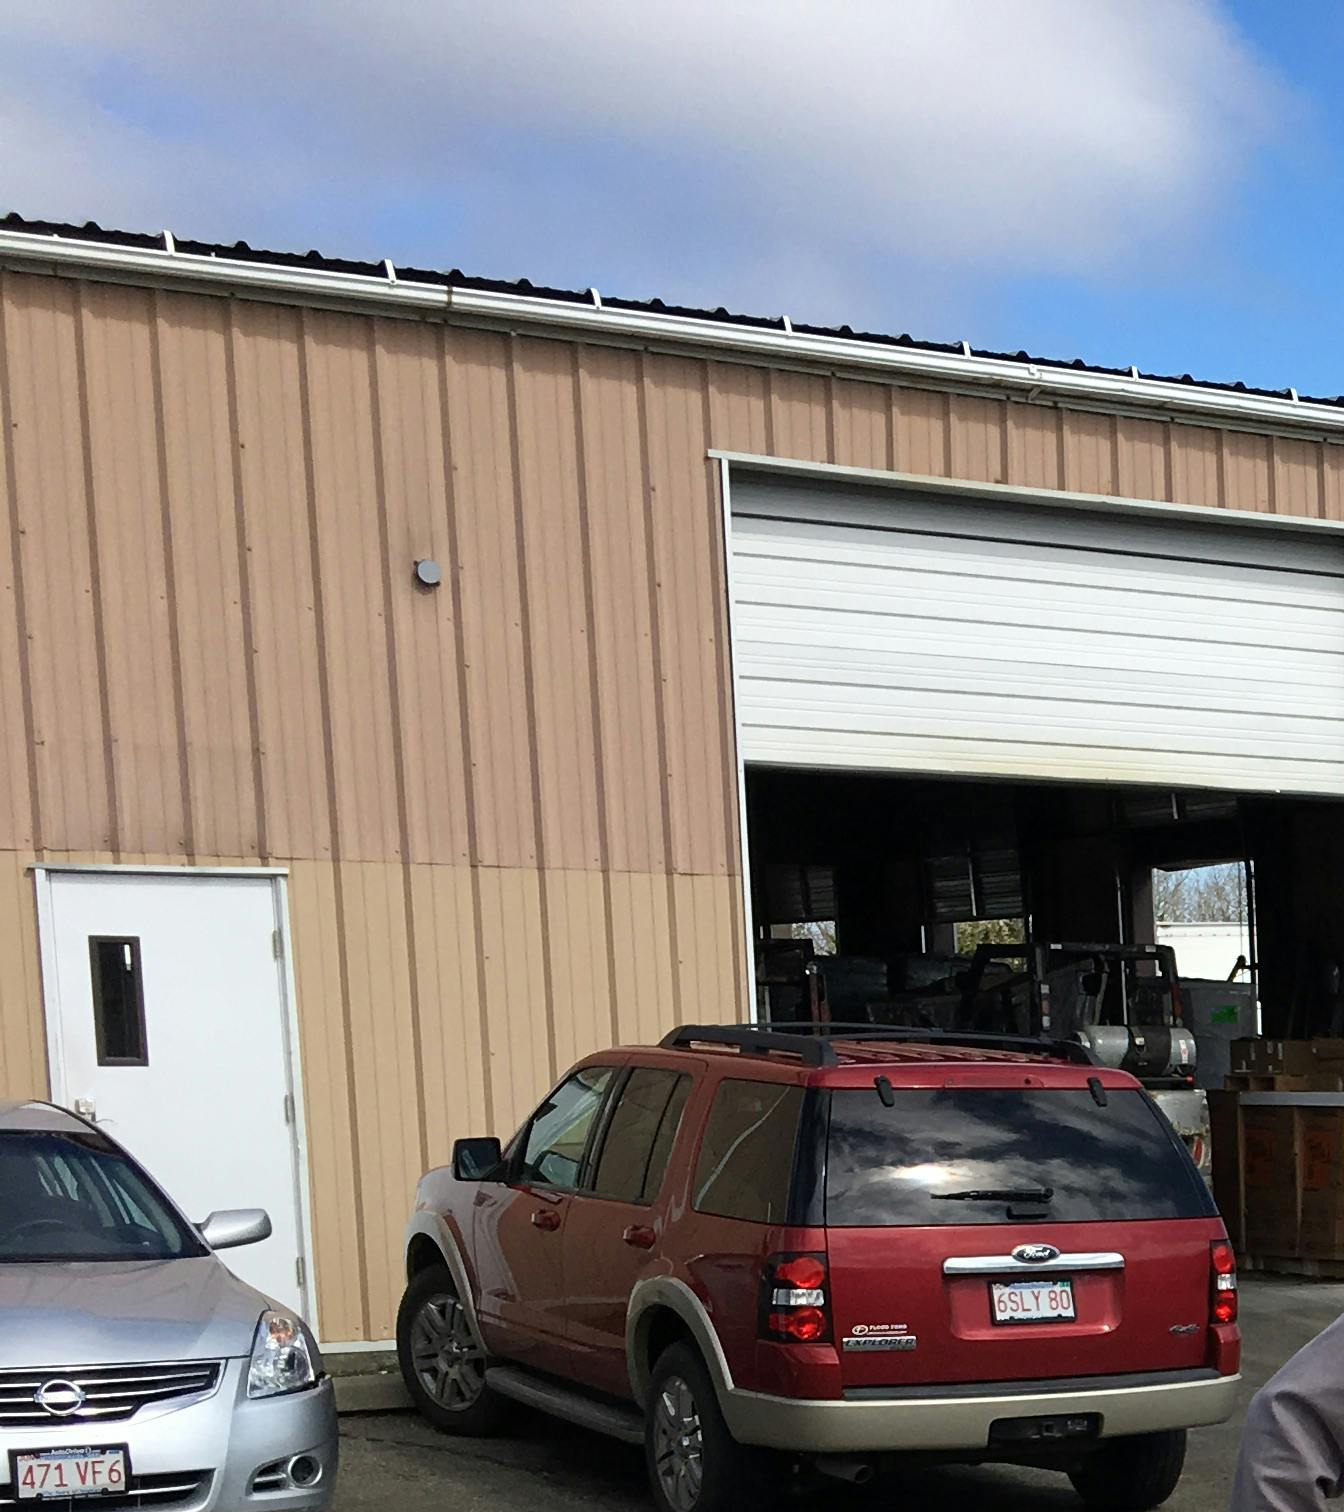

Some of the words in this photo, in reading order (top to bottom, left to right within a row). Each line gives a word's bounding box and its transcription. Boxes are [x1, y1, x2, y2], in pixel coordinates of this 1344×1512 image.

[996, 1290, 1042, 1313] 6SLY
[1048, 1289, 1071, 1311] 80
[22, 1463, 68, 1489] 471
[75, 1460, 122, 1485] VF6
